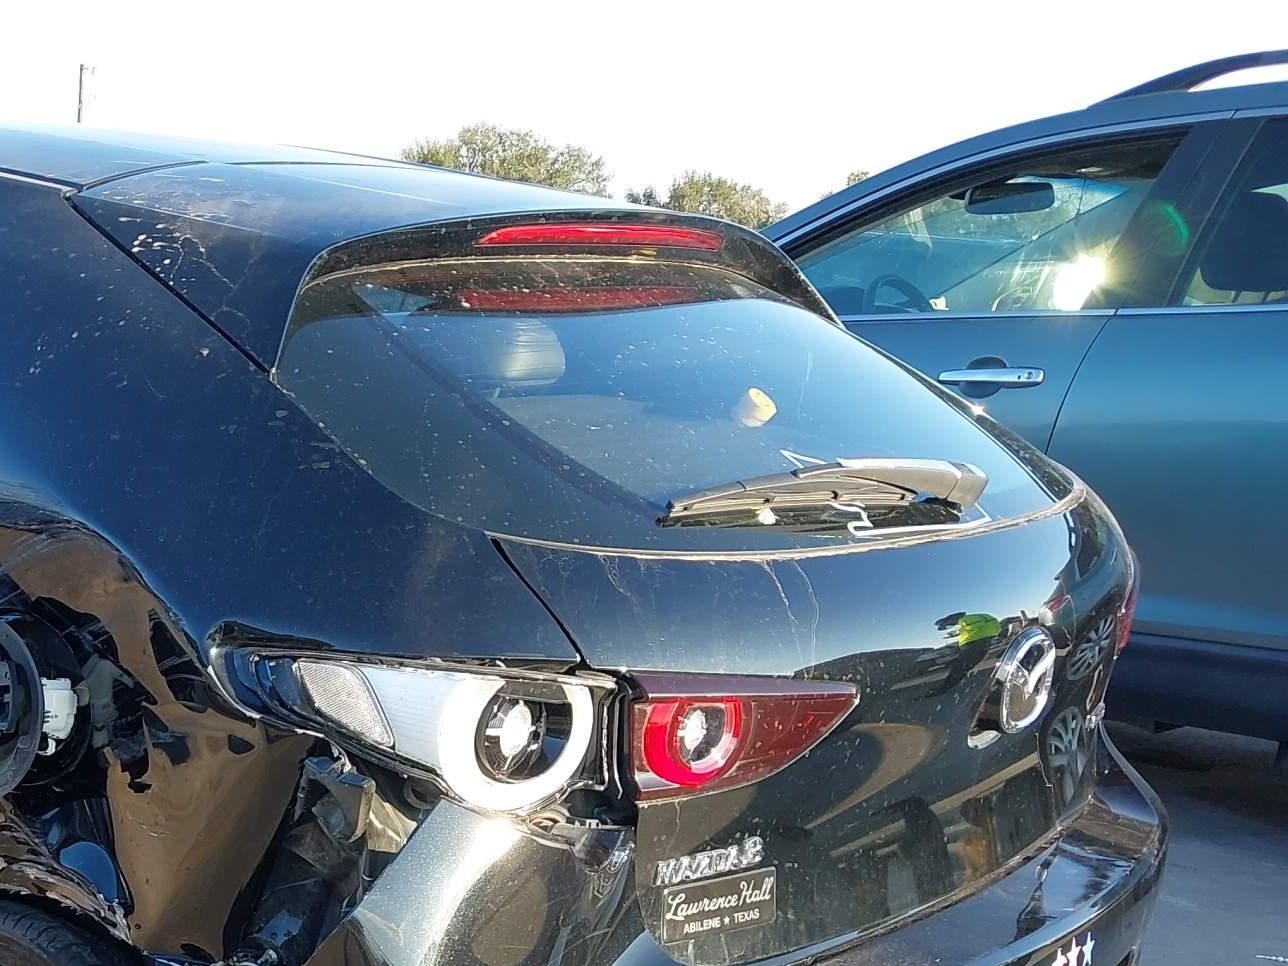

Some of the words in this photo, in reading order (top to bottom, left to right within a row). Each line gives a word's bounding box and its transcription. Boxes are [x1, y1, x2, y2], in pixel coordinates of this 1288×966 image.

[665, 893, 739, 920] Lawrence
[738, 876, 773, 906] Hall
[683, 916, 721, 934] ABILENE
[733, 908, 760, 923] TEXAS
